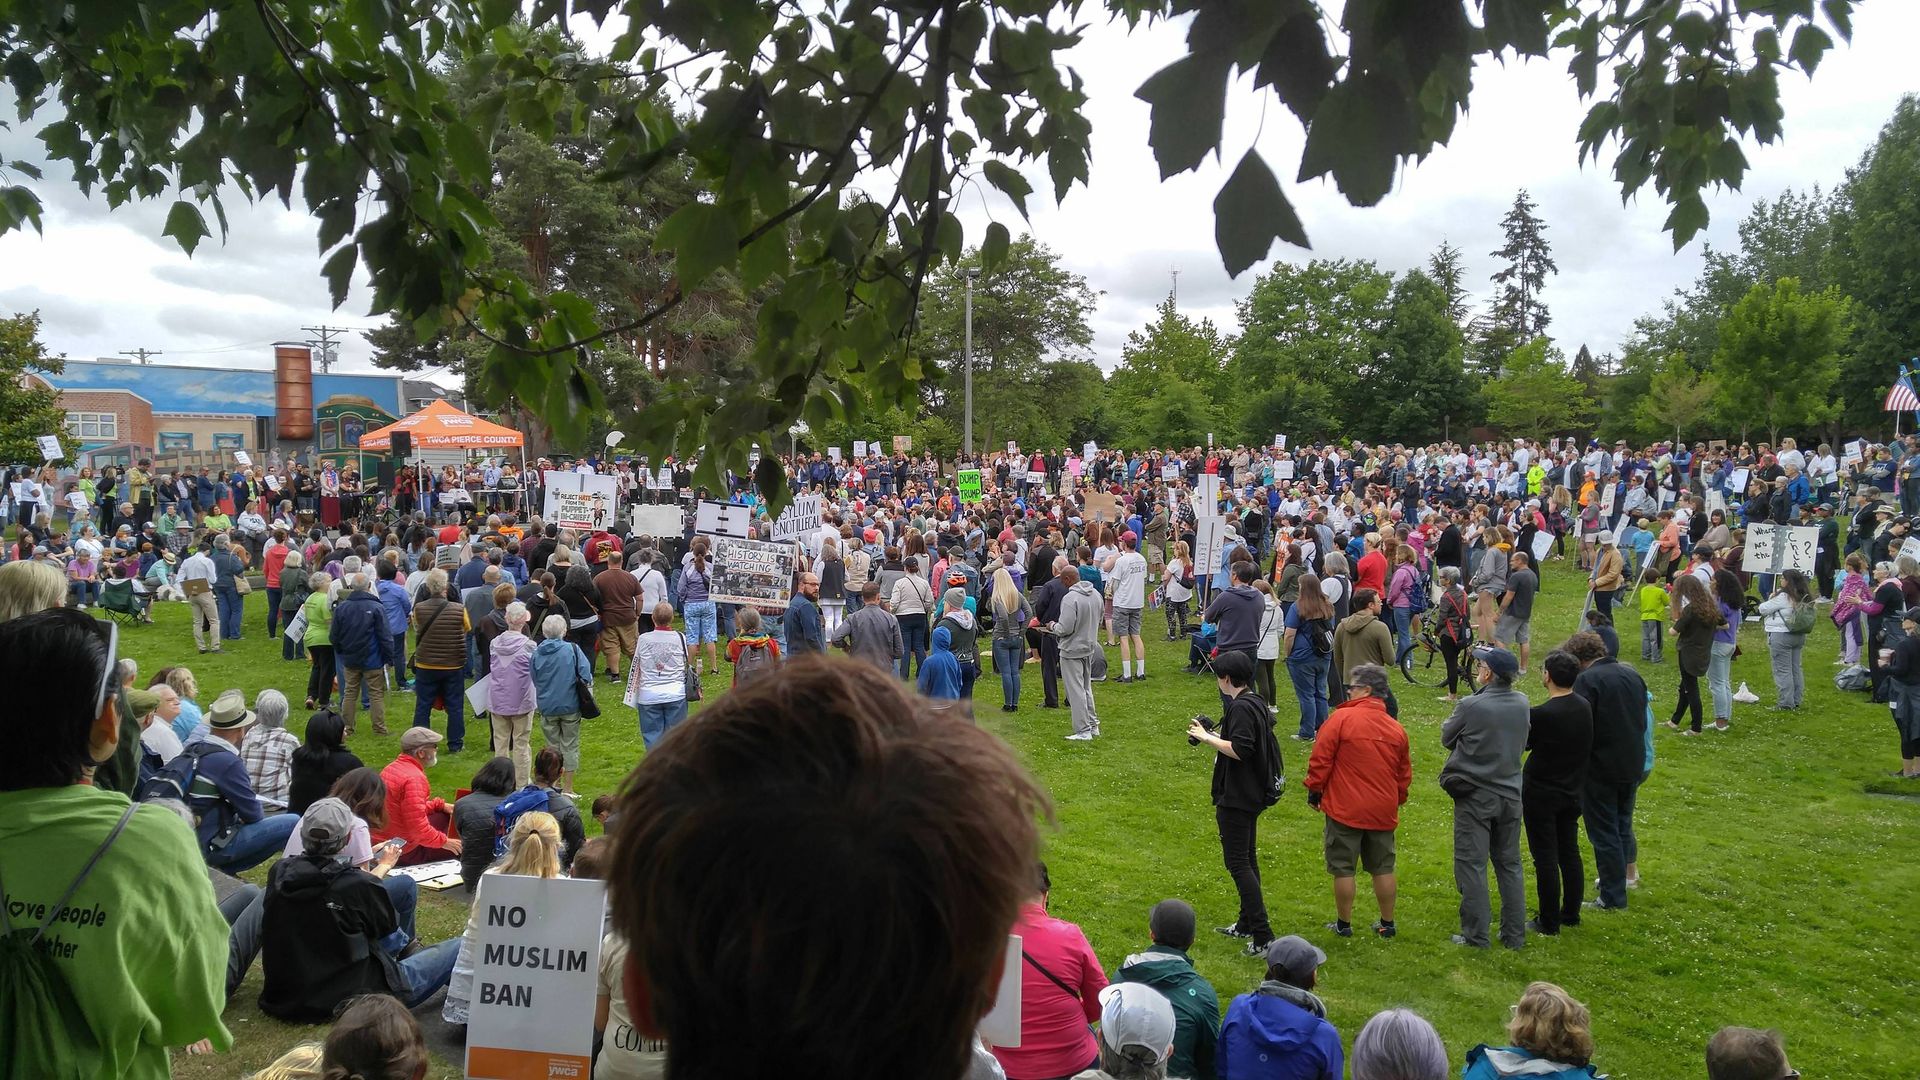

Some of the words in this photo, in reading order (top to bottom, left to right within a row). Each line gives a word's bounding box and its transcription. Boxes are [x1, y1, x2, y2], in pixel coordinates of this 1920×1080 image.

[425, 436, 450, 444] YWCA
[451, 436, 482, 444] PIERCE
[483, 436, 517, 444] COUNTY
[960, 474, 979, 484] DUMP
[960, 488, 981, 500] TRUMP
[561, 505, 589, 514] PUPPET-
[780, 500, 816, 521] SYLUM
[772, 522, 780, 537] IS
[779, 519, 796, 536] NOT
[795, 515, 822, 533] ILLEGAL
[1753, 526, 1776, 536] Where
[728, 549, 765, 562] HISTORY
[767, 553, 776, 564] IS
[728, 561, 772, 573] WATCHING
[487, 904, 526, 928] NO
[46, 934, 78, 959] ther
[483, 944, 588, 973] MUSLIM
[479, 982, 533, 1008] BAN
[548, 1065, 578, 1077] ywca
